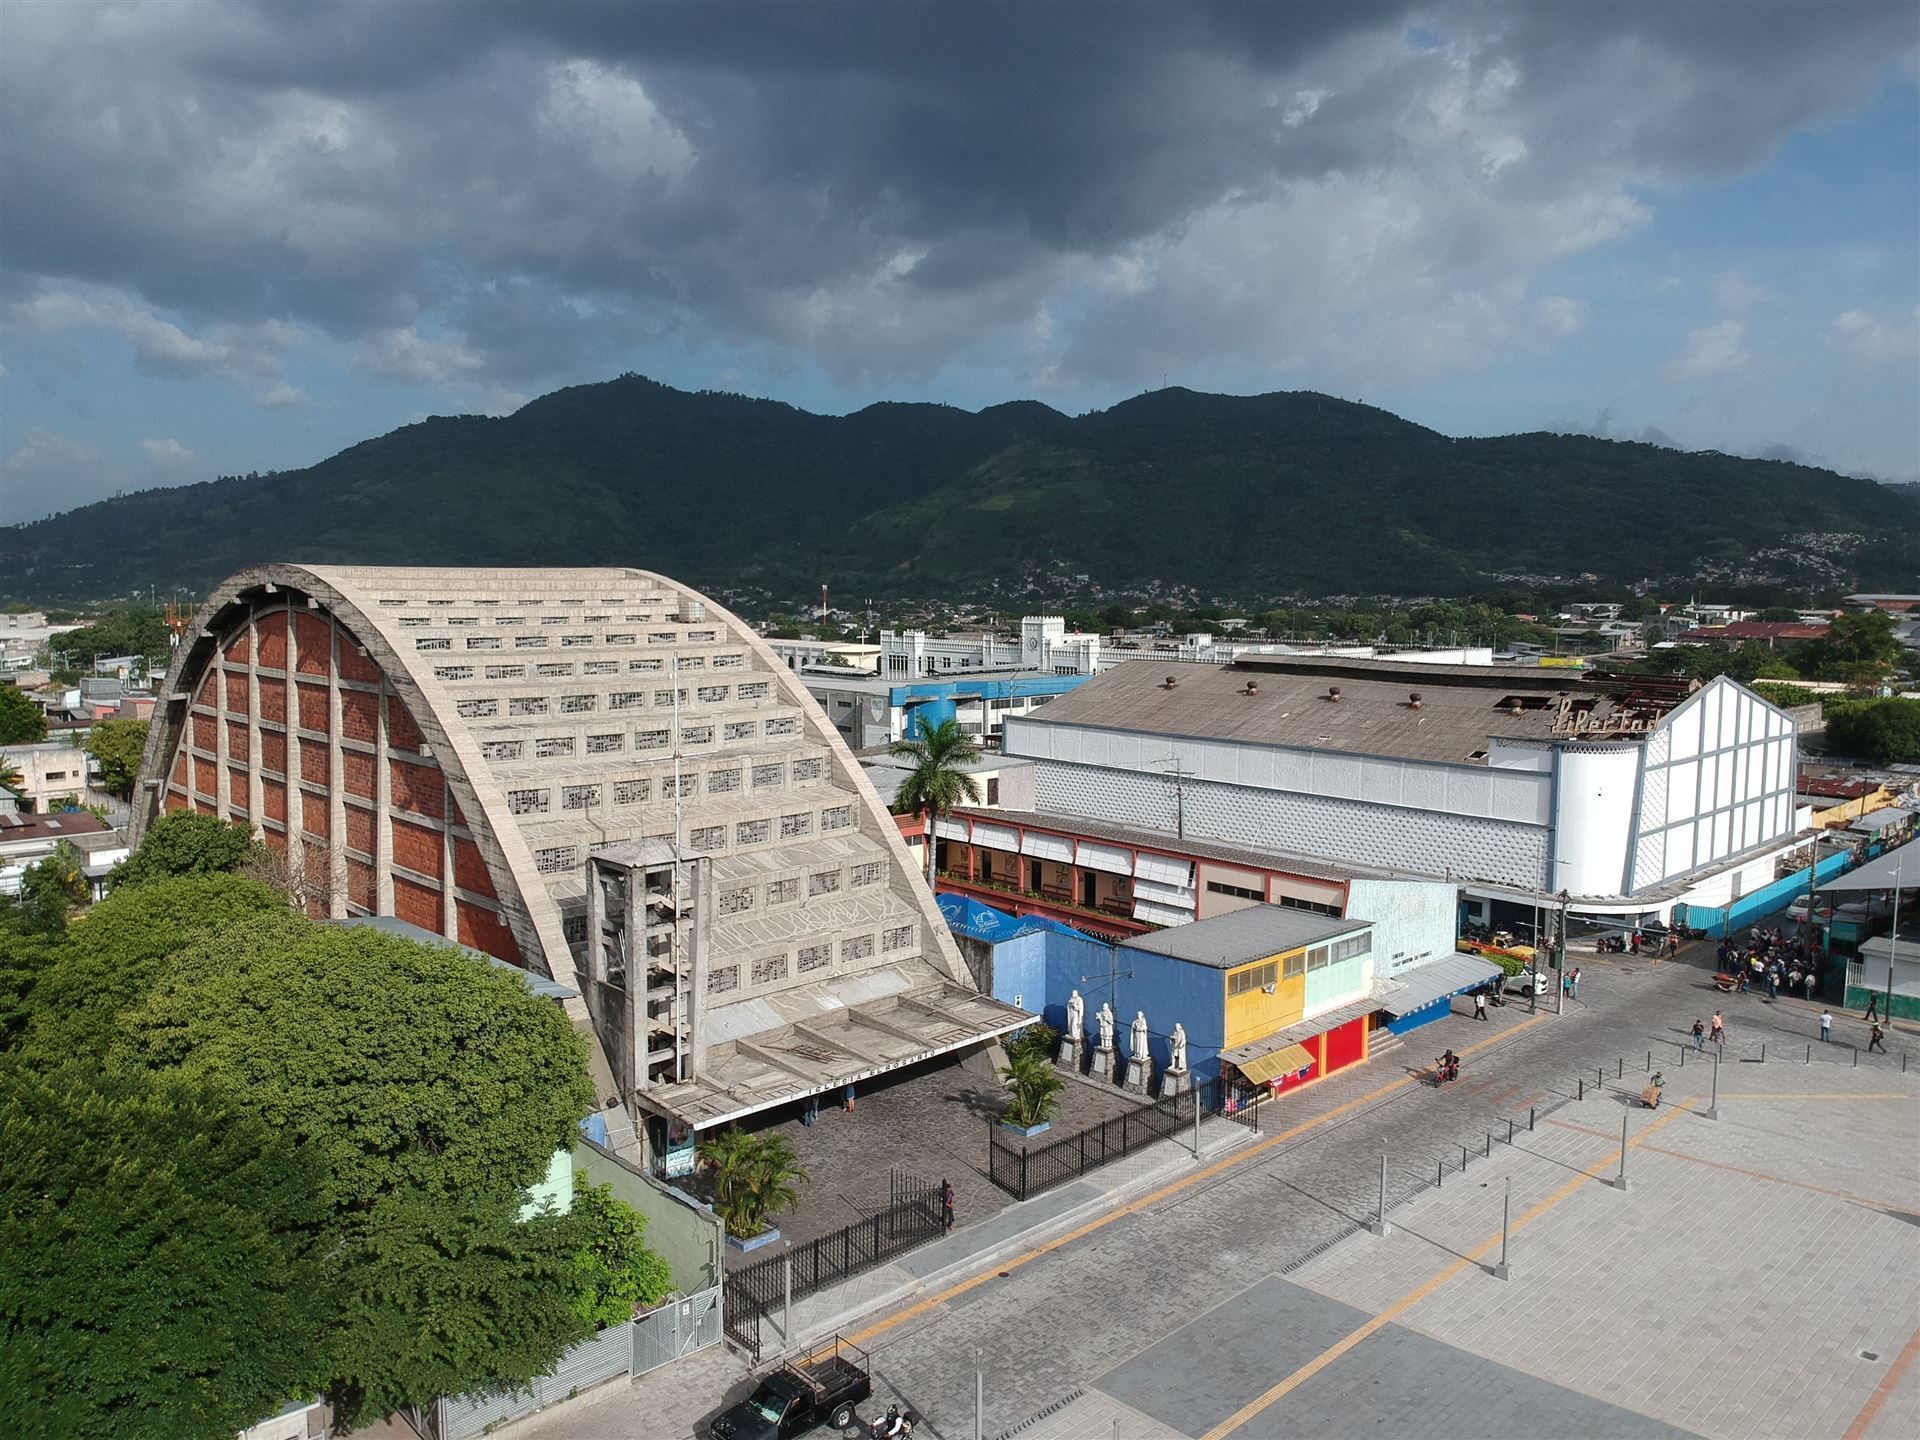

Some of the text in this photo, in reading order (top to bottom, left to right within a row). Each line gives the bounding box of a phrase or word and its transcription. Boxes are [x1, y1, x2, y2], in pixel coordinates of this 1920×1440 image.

[1551, 698, 1661, 733] Libertad
[808, 1074, 861, 1095] IGLESIA
[885, 1051, 936, 1071] ROSARIO
